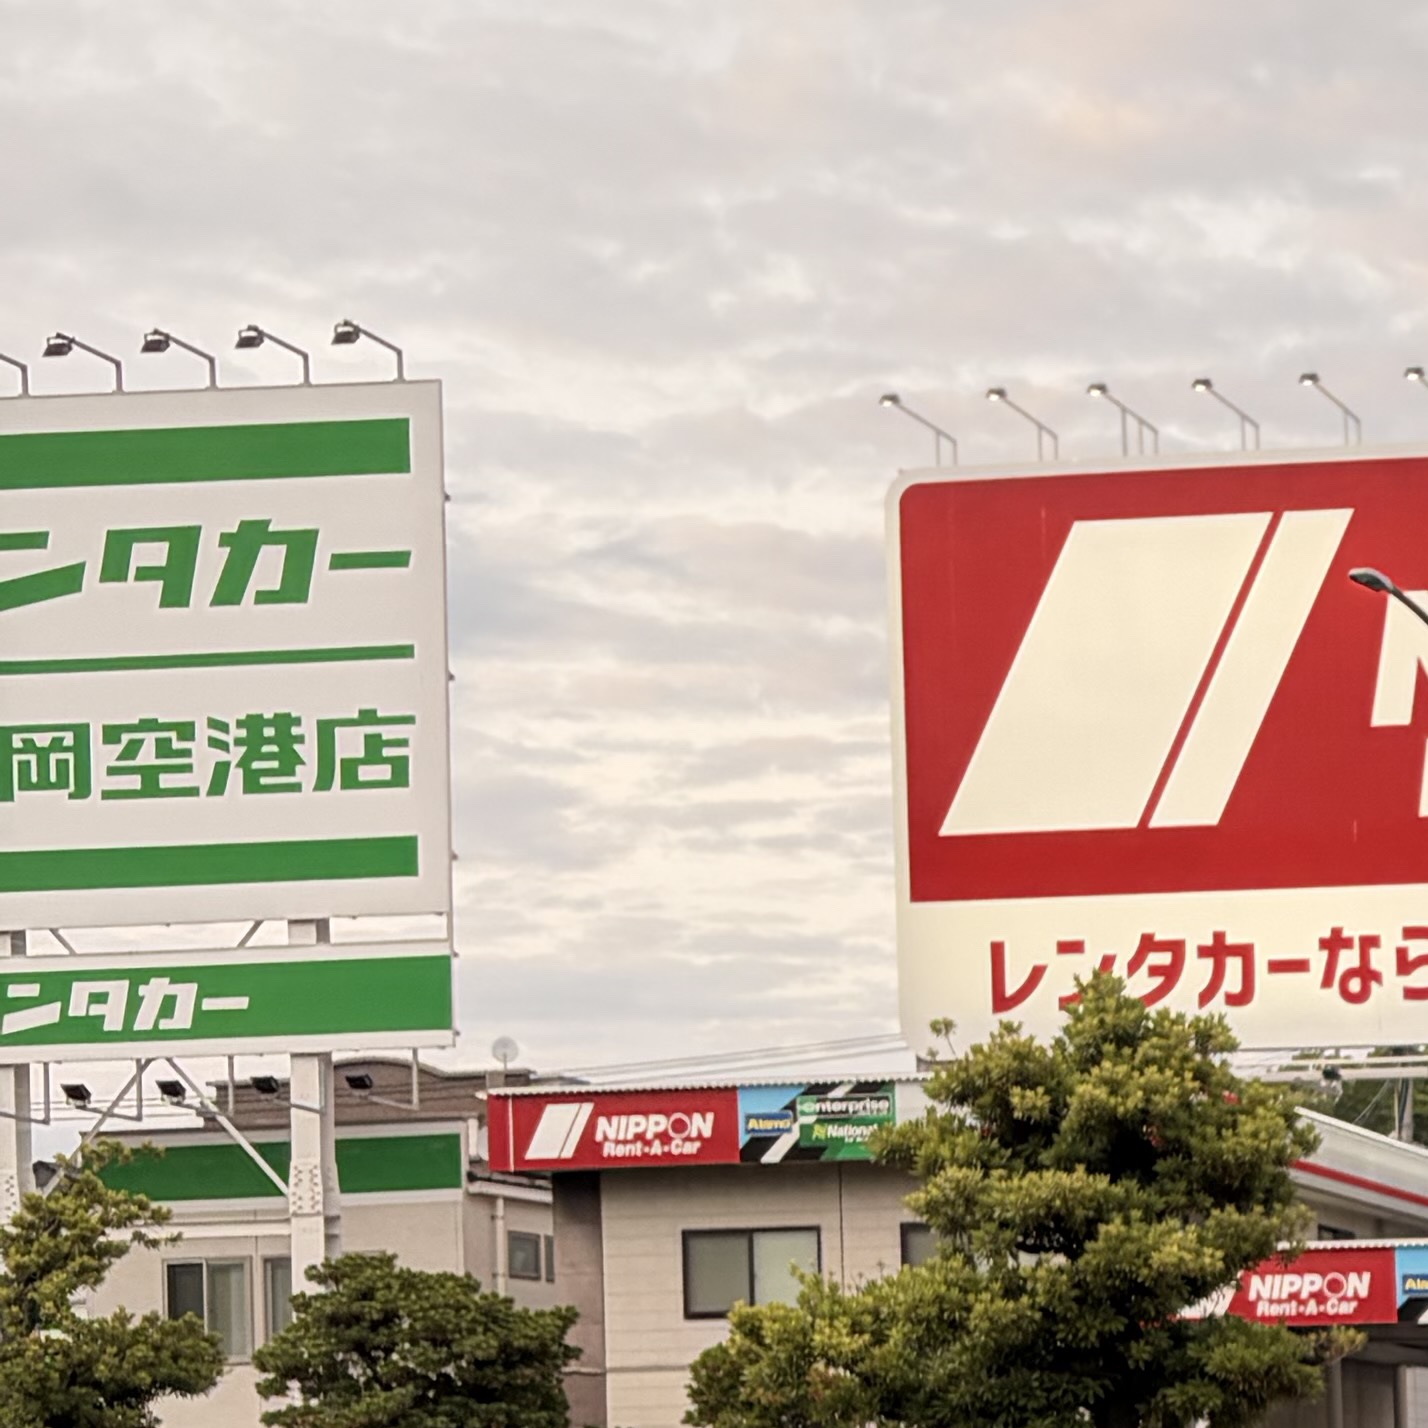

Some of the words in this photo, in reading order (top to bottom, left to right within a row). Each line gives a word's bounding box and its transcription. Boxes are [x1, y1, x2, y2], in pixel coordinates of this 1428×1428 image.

[0, 708, 416, 802] 岡空港店
[2, 977, 250, 1035] ンタカー
[798, 1097, 889, 1114] enterprise
[595, 1112, 715, 1142] NIPPON
[1248, 1271, 1372, 1302] NIPPON
